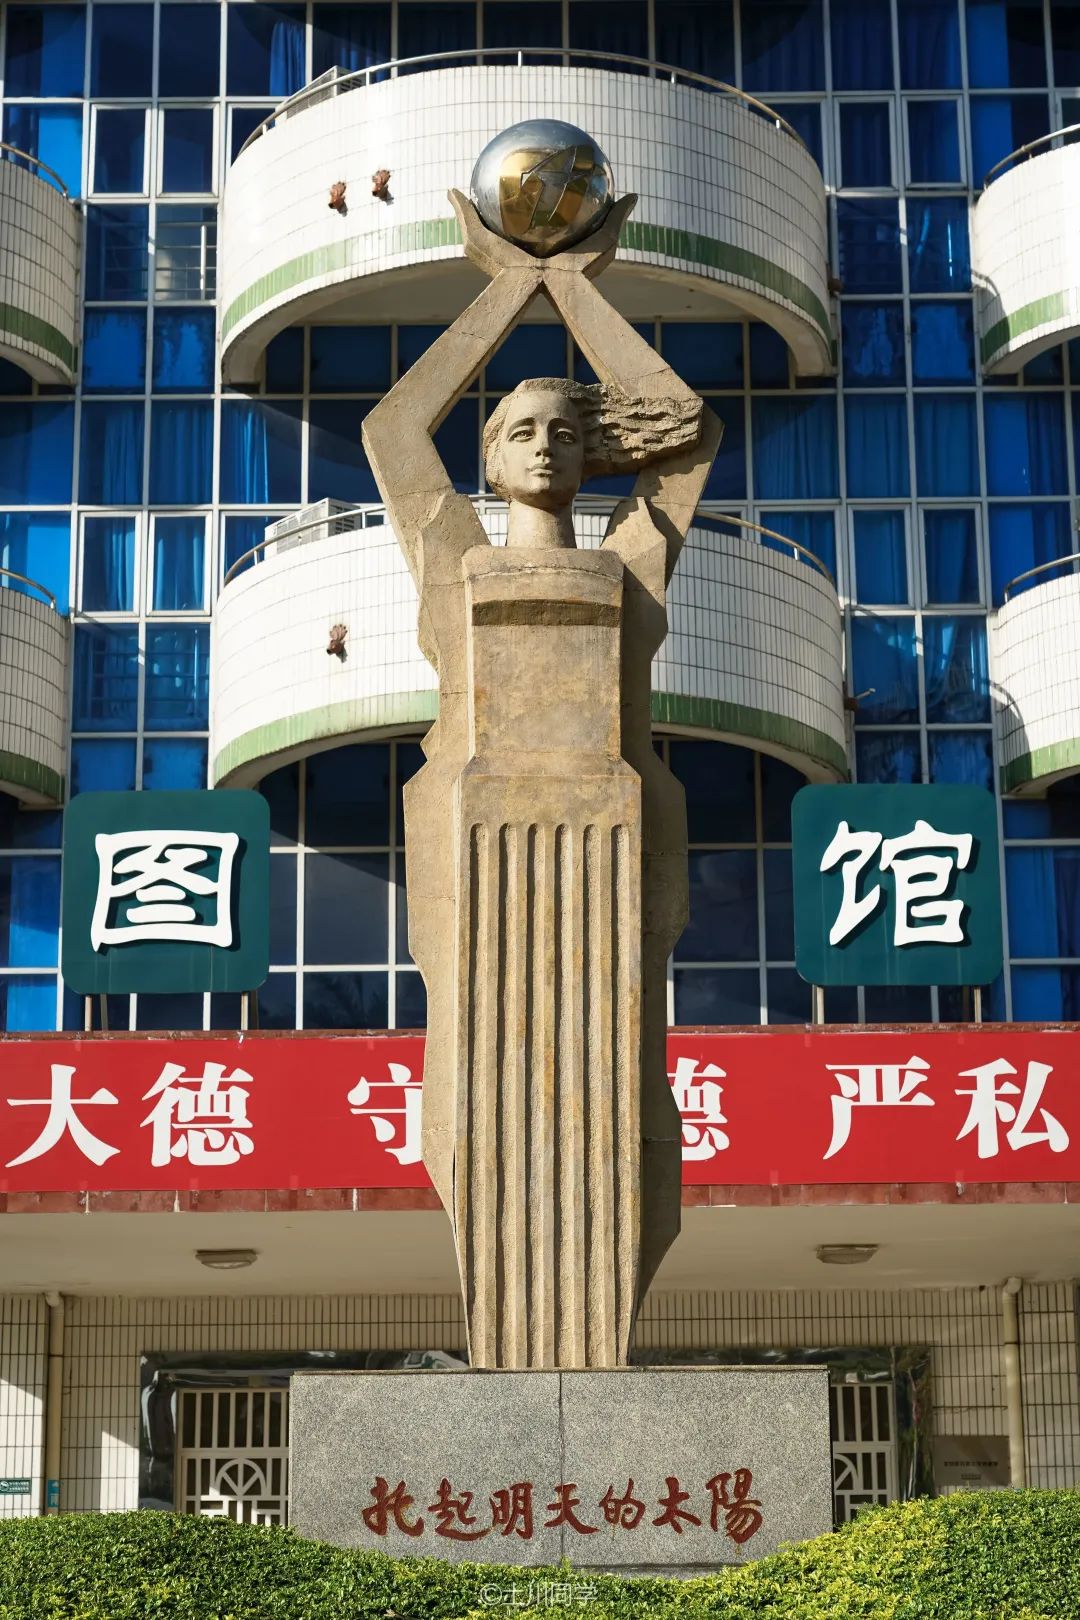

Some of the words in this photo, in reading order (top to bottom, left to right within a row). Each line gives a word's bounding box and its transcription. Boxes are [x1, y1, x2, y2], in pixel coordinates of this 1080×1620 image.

[91, 829, 240, 952] 图
[820, 819, 973, 946] 馆
[6, 1062, 255, 1168] 大德
[823, 1056, 1070, 1160] 严私
